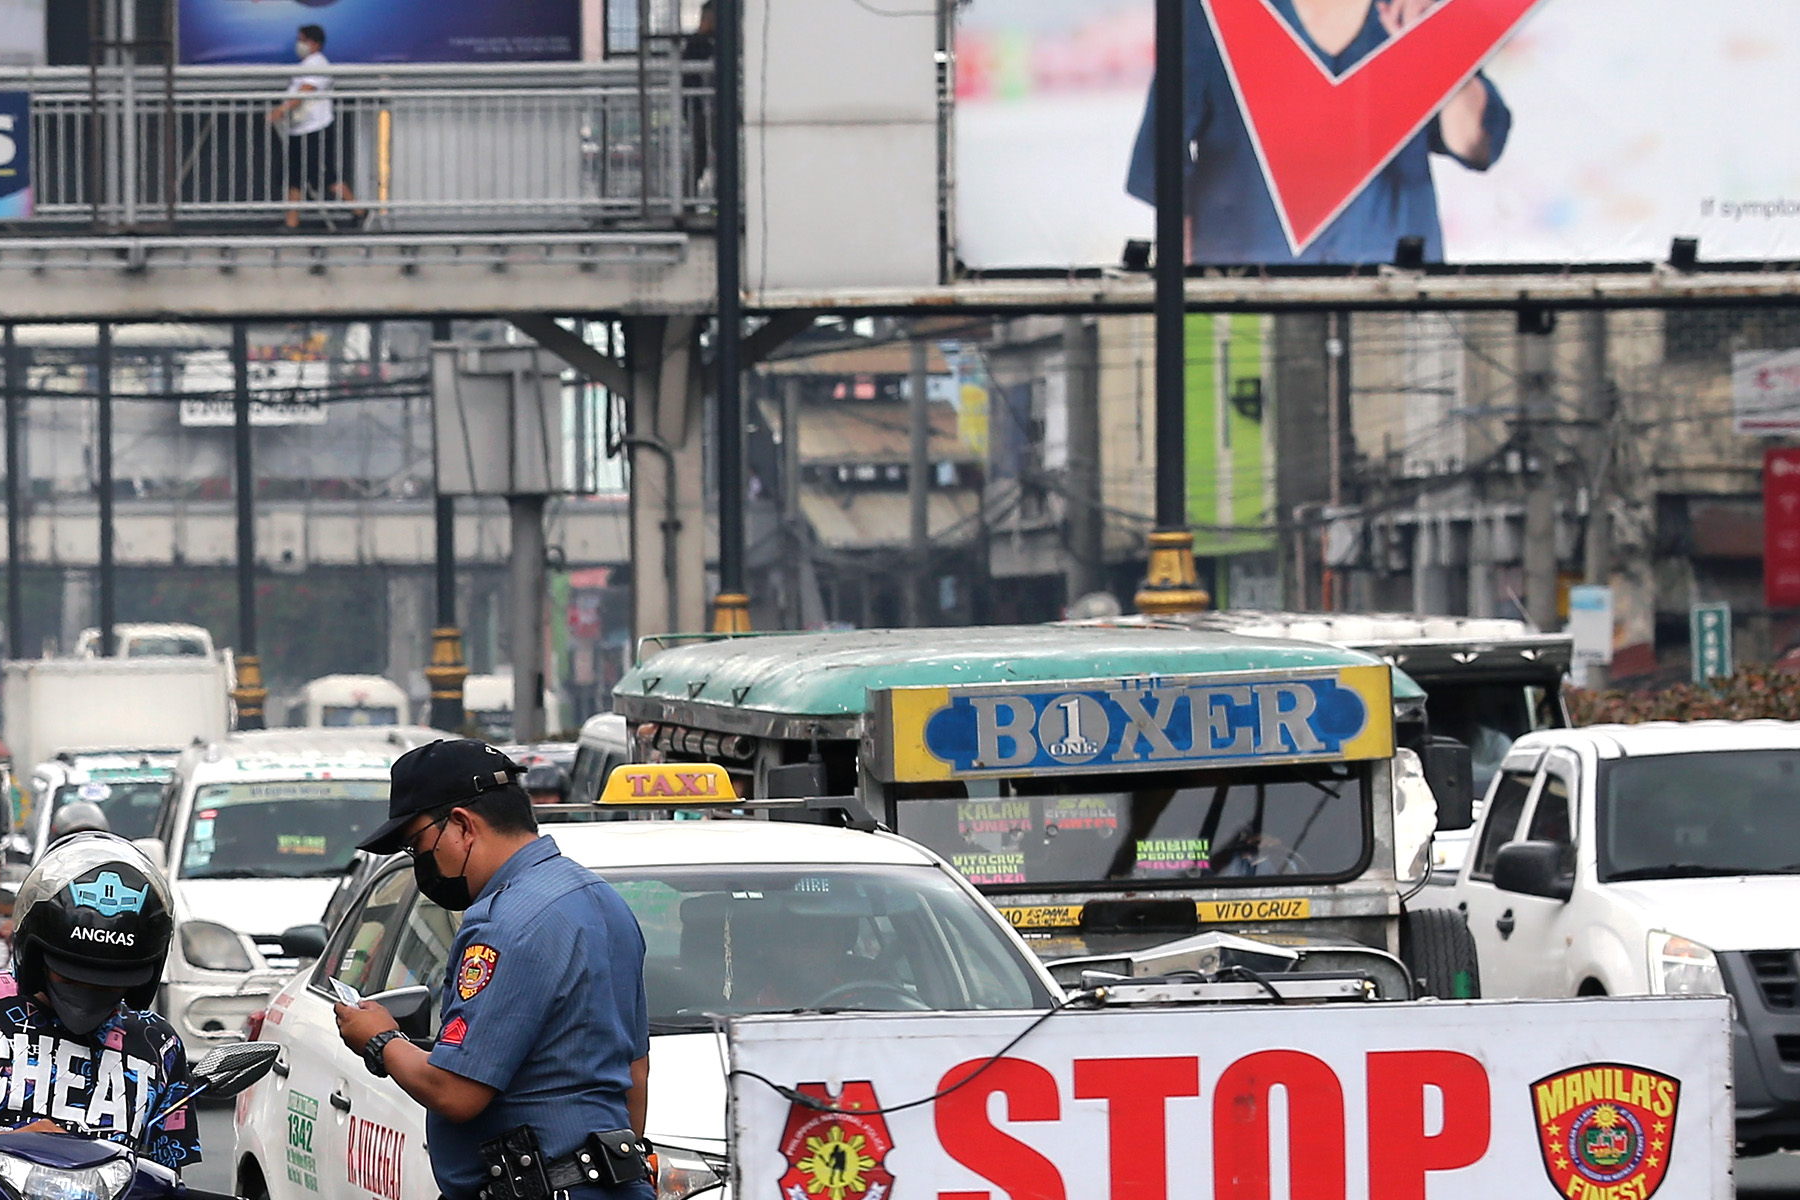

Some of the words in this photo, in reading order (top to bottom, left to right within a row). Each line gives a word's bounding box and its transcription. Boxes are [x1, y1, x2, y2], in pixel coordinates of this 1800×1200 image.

[1720, 197, 1800, 221] sympto
[1050, 741, 1099, 757] ONE
[626, 773, 718, 797] TAXI
[957, 801, 1031, 820] KALAW
[1136, 839, 1209, 853] MABINI
[960, 864, 1018, 875] MABINI
[1216, 903, 1254, 919] VITO
[1256, 901, 1302, 917] CRUZ
[71, 926, 135, 946] ANGKAS
[1537, 1068, 1674, 1125] MANILA'S
[287, 1114, 313, 1153] 1342
[863, 1124, 886, 1151] POLICE
